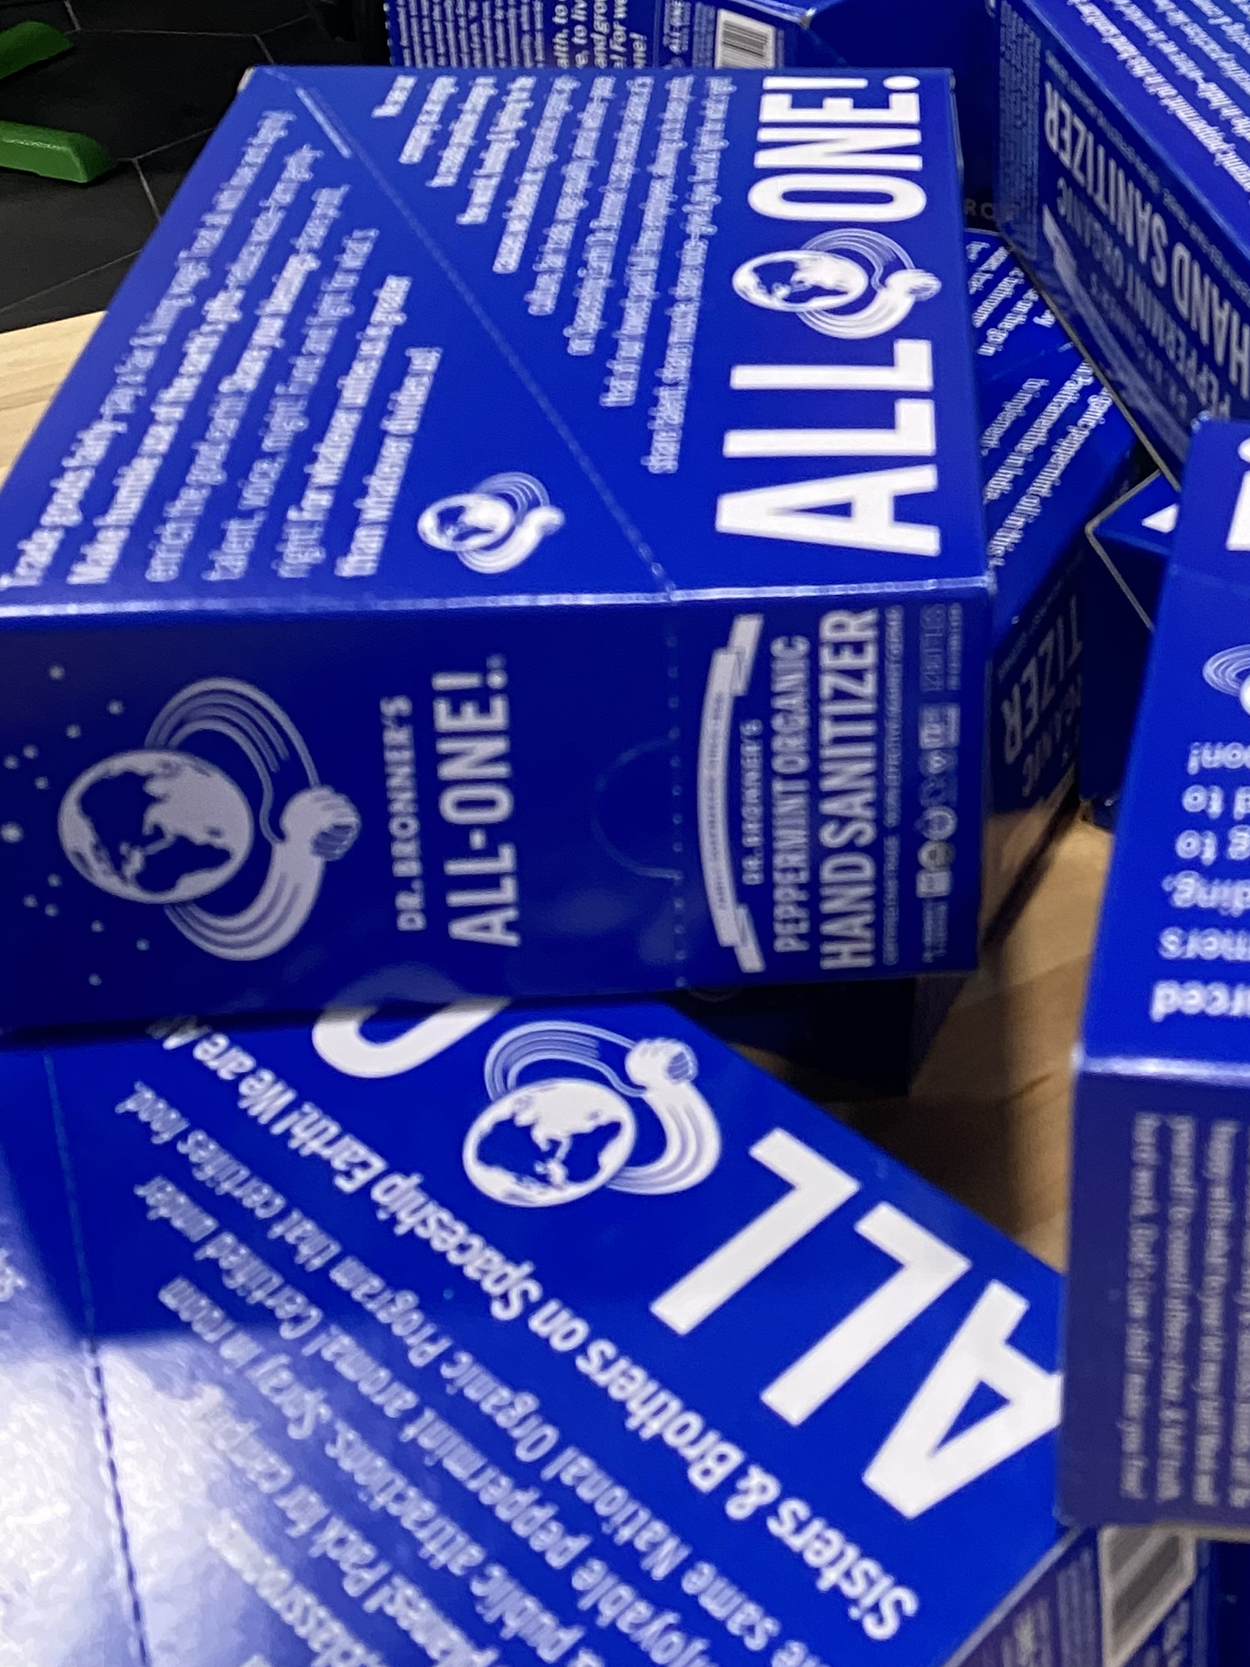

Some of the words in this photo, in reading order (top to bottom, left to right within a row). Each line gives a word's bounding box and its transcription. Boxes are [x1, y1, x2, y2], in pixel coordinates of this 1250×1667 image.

[552, 5, 568, 24] to
[591, 33, 611, 69] and
[610, 21, 626, 52] For
[748, 76, 926, 222] ONE!
[1045, 80, 1168, 288] SANITIZER
[1171, 242, 1250, 400] HAND
[716, 335, 940, 556] ALL
[771, 636, 810, 774] ORGANIC
[819, 609, 878, 847] SANITIZER
[380, 697, 422, 876] BRONNER'S
[432, 667, 520, 946] ALL-ONE!
[1175, 818, 1217, 865] to
[1182, 785, 1223, 818] to
[395, 880, 425, 930] DR.
[772, 777, 809, 952] PEPPERMINT
[820, 853, 875, 969] HAND
[115, 1082, 200, 1144] food.
[193, 1036, 264, 1080] are
[228, 1069, 312, 1122] We
[154, 1131, 285, 1219] certifies
[258, 1103, 398, 1193] Earth!
[134, 1176, 218, 1242] under
[268, 1210, 341, 1271] that
[348, 1174, 552, 1320] Spaceship
[195, 1232, 323, 1346] Certified
[329, 1257, 452, 1368] Program
[512, 1300, 590, 1352] on
[650, 1128, 1063, 1518] ALL
[279, 1325, 419, 1418] aroma!
[440, 1351, 559, 1462] Organic
[576, 1340, 744, 1493] Brothers
[398, 1408, 591, 1569] peppermint
[541, 1447, 690, 1580] National
[725, 1466, 781, 1520] &
[682, 1562, 780, 1651] same
[767, 1498, 918, 1640] Sisters
